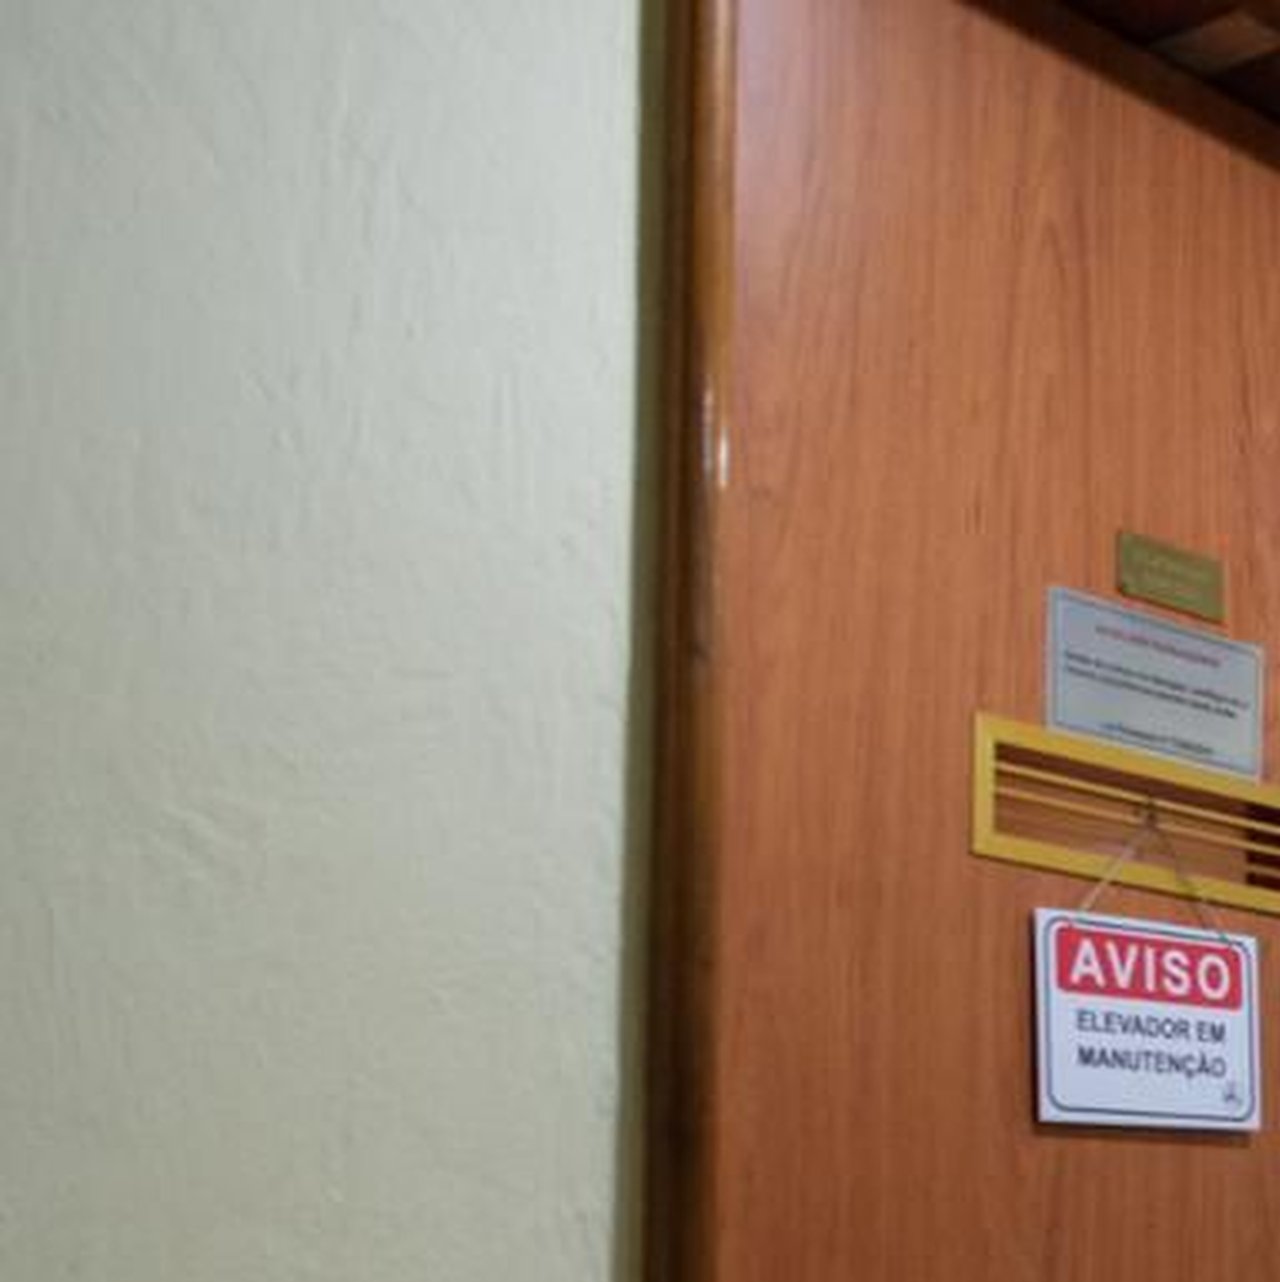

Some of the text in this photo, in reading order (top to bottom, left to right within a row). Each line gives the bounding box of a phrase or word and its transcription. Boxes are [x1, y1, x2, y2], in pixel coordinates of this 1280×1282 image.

[1070, 938, 1230, 1000] AVISO
[1076, 1008, 1226, 1044] ELEVADOR EM
[1076, 1044, 1227, 1079] MANUTENÇÃO
